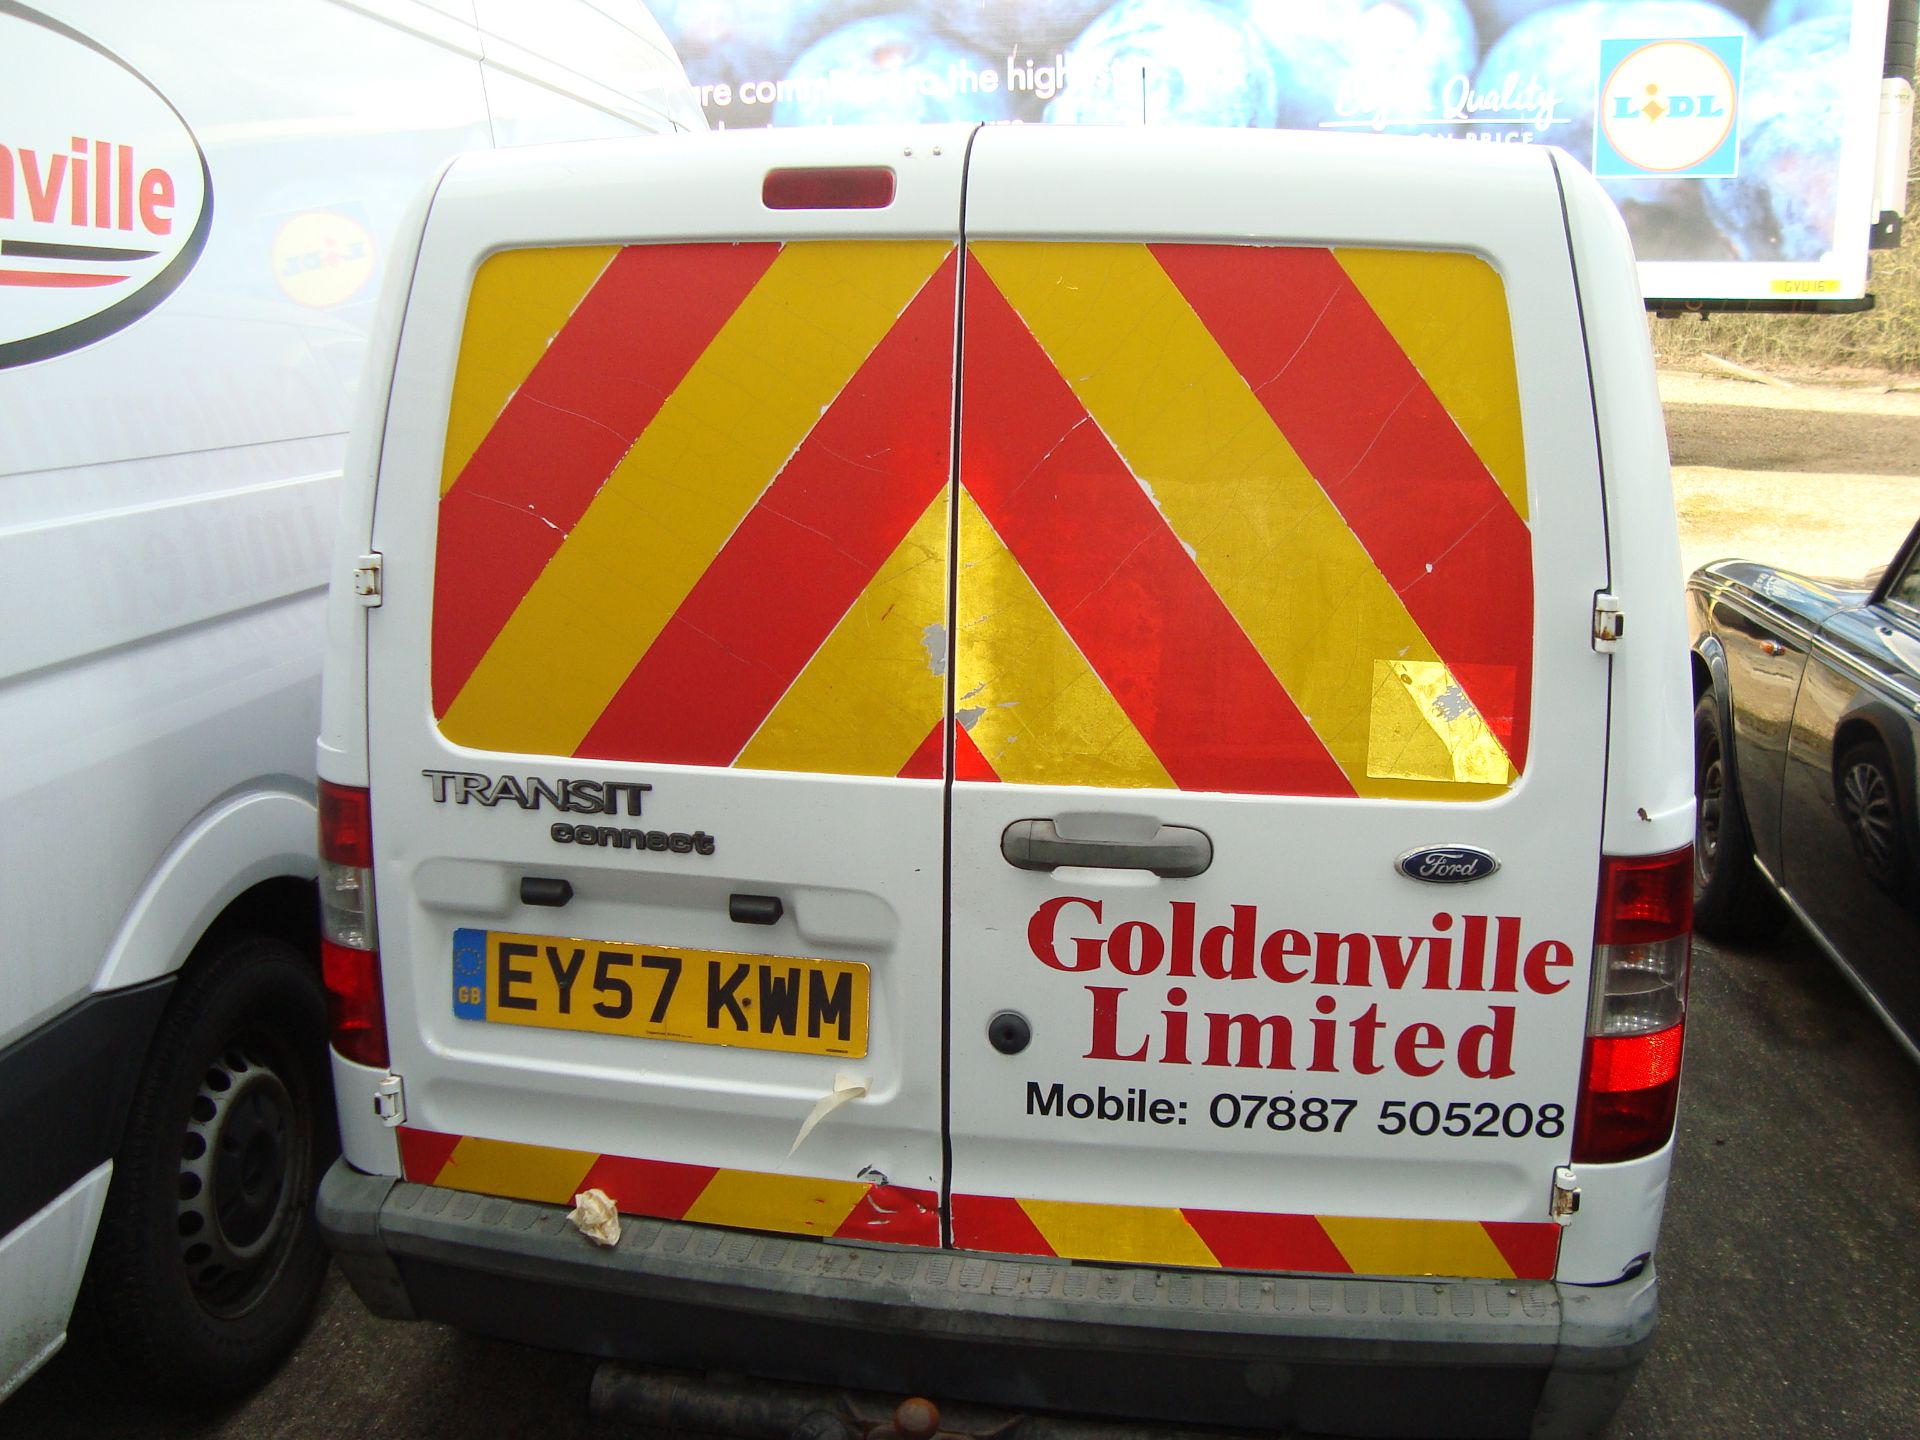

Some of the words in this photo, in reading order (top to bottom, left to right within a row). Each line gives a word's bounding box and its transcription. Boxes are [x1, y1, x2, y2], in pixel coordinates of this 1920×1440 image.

[1443, 71, 1563, 131] Quality
[422, 769, 652, 816] TRANSIT
[550, 822, 715, 855] connect
[1418, 851, 1477, 877] Ford
[1027, 896, 1574, 994] Goldenville
[458, 985, 480, 1005] GB
[498, 941, 682, 1023] EY57
[706, 960, 853, 1041] KWM
[1082, 985, 1516, 1080] Limited
[1026, 1081, 1188, 1127] Mobile:
[1209, 1094, 1358, 1133] 07887
[1377, 1100, 1565, 1138] 505208
